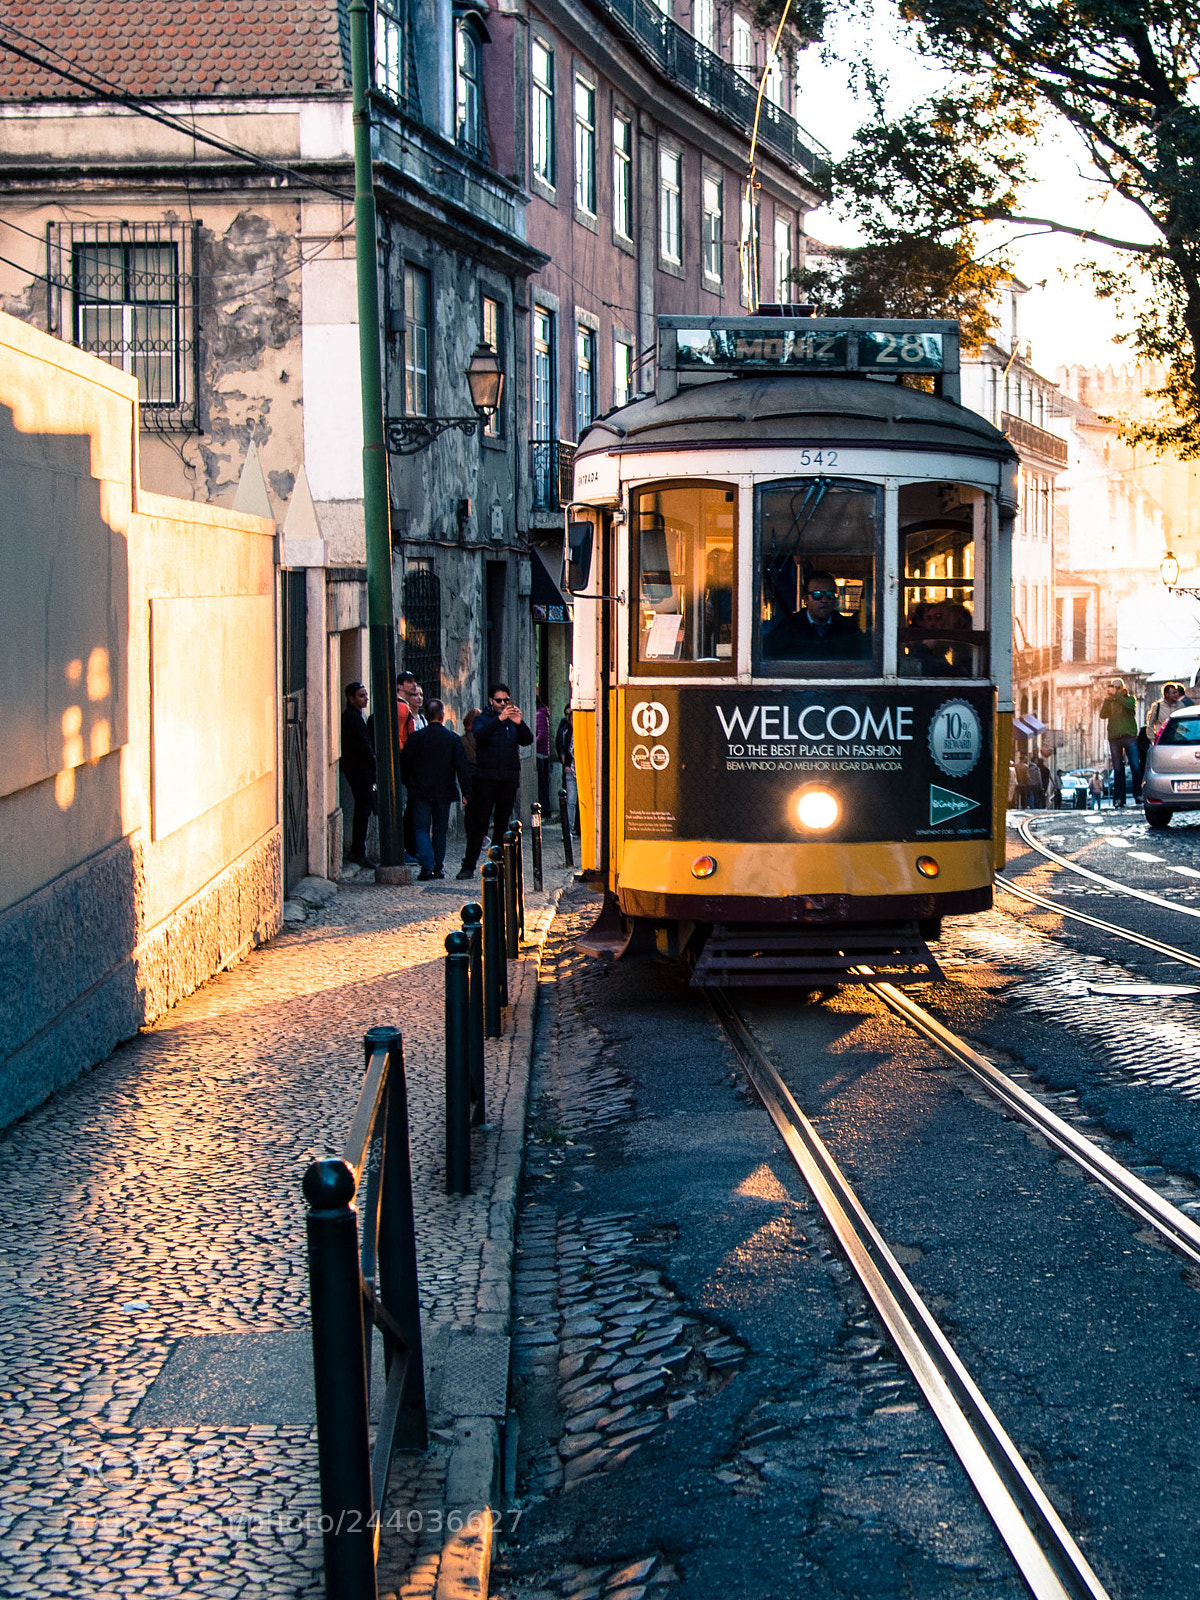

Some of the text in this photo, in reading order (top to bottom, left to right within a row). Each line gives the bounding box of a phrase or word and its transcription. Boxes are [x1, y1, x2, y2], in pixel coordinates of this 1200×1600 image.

[737, 337, 835, 359] MONIZ
[876, 333, 925, 362] 28
[800, 450, 838, 466] 542
[715, 705, 914, 741] WELCOME
[945, 712, 972, 739] 10%
[727, 744, 902, 757] TO THE BEST PLACE IN FASHION
[726, 761, 903, 772] BEM-VINDO AO MELHOR LUGAR DA MODA
